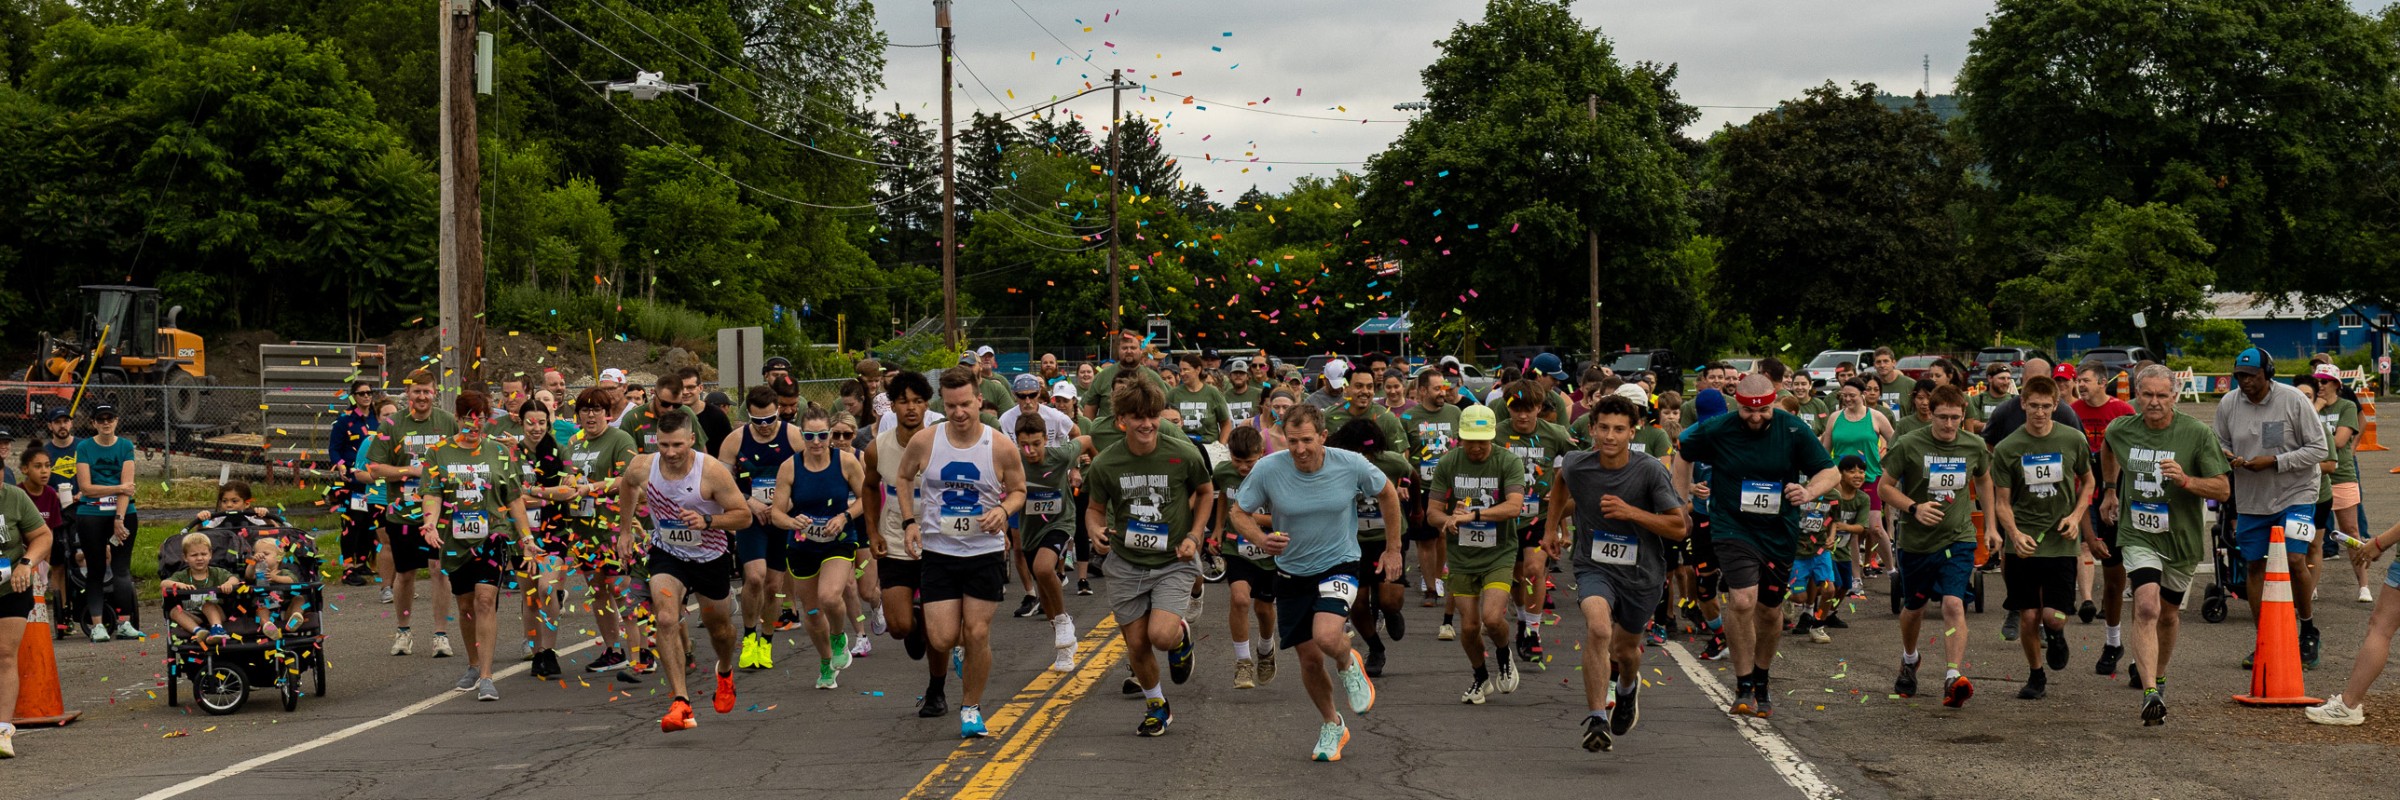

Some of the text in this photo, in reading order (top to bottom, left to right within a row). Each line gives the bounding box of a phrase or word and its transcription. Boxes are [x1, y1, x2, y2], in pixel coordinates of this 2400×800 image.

[178, 348, 195, 357] 621G
[2036, 466, 2050, 478] 64
[941, 461, 981, 505] S
[1120, 474, 1168, 488] ORLANDO JOSIAH
[1454, 476, 1498, 489] ORLANDO JOSIAH
[1941, 474, 1954, 486] 68
[1034, 501, 1054, 511] 872
[1754, 494, 1768, 508] 45
[954, 517, 970, 531] 43
[1806, 519, 1822, 529] 229
[2138, 513, 2159, 528] 843
[460, 521, 480, 534] 449
[2297, 522, 2309, 536] 73
[669, 530, 692, 542] 440
[1134, 534, 1158, 549] 382
[1470, 531, 1484, 542] 26
[1246, 546, 1266, 556] 34
[1601, 543, 1627, 558] 487
[1333, 581, 1349, 595] 99
